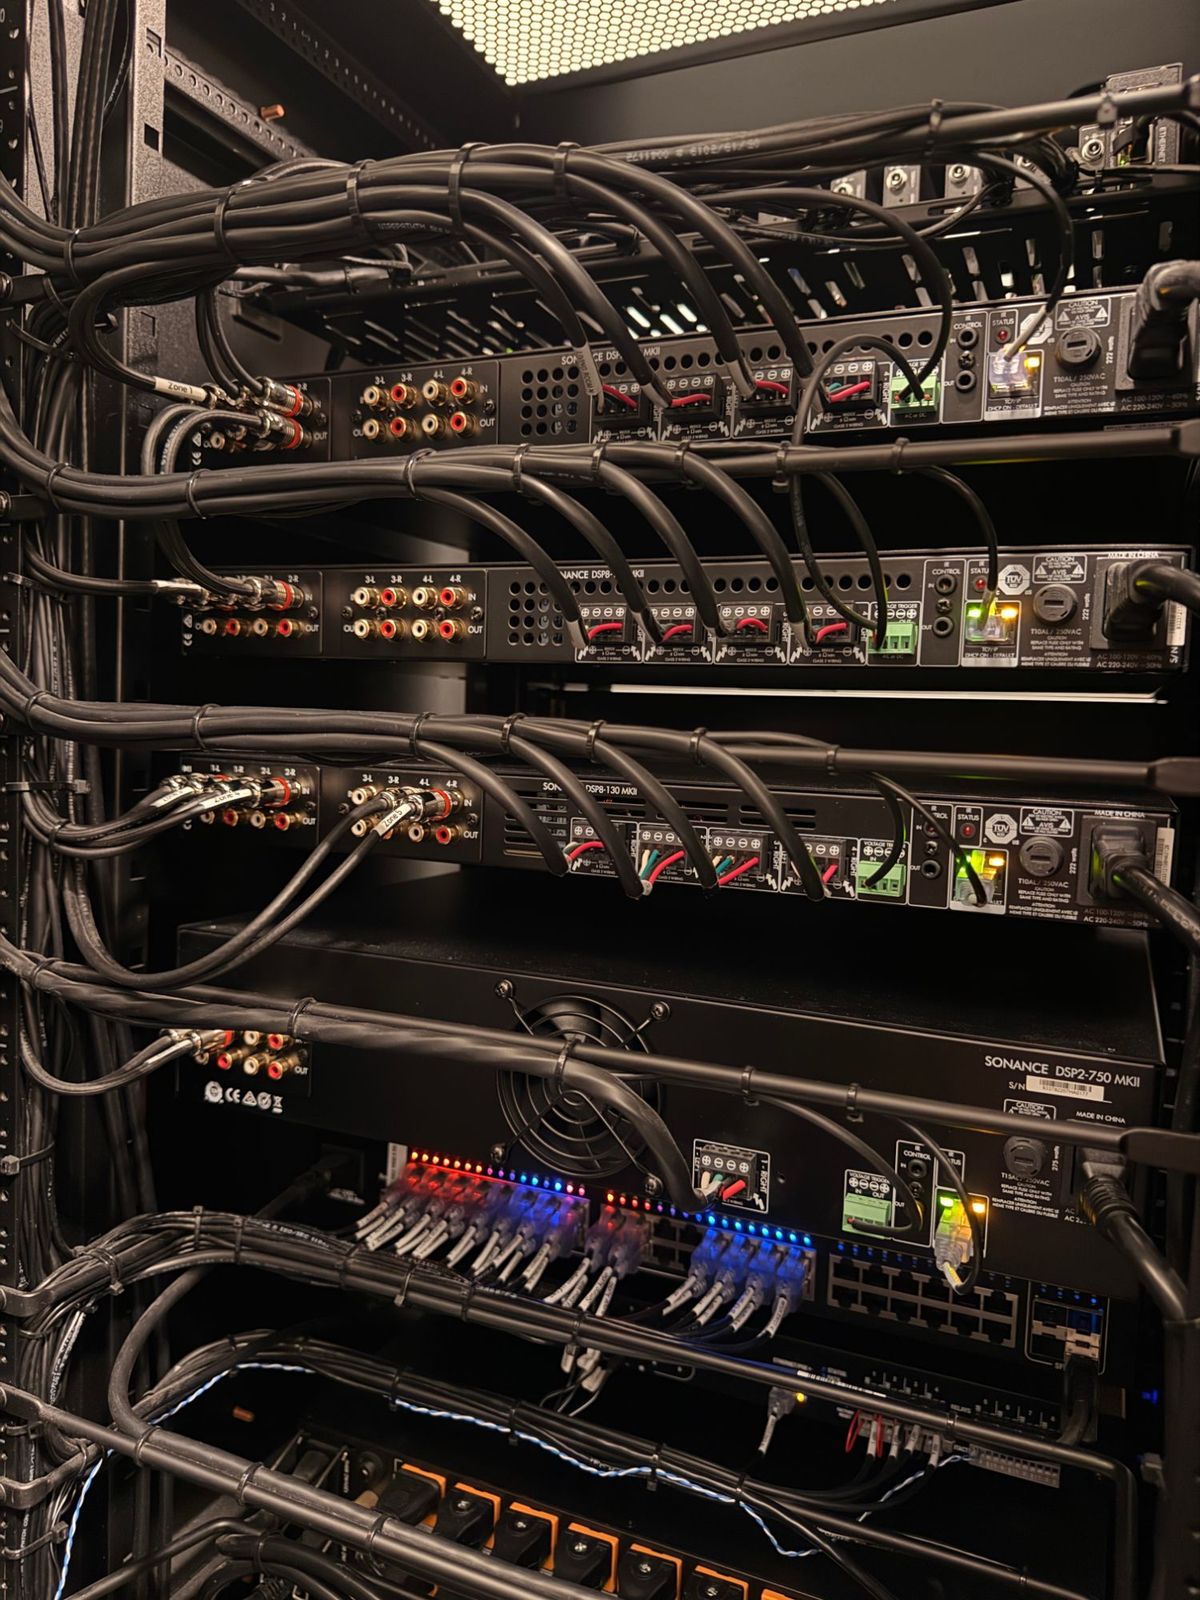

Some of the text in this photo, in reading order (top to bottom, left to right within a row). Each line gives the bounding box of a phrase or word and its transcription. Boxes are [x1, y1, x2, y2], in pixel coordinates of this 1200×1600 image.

[954, 321, 983, 331] CONTROL
[992, 319, 1014, 328] STATUS
[561, 351, 604, 366] SONCE
[433, 370, 444, 379] 4-L
[461, 367, 473, 376] 4-R
[374, 376, 385, 385] 3-L
[401, 373, 413, 383] 3-R
[168, 380, 188, 393] Zone
[479, 385, 489, 393] IN
[314, 401, 322, 409] IN
[479, 418, 496, 428] OUT
[313, 432, 327, 442] OUT
[932, 568, 961, 577] CONTROL
[971, 568, 989, 577] STATU
[288, 575, 299, 583] 2-R
[365, 575, 375, 583] 3-L
[391, 575, 402, 583] 3-R
[423, 575, 433, 583] 4-L
[450, 575, 461, 583] 4-R
[468, 593, 476, 601] IN
[305, 624, 319, 633] OUT
[467, 626, 483, 635] OUT
[285, 769, 296, 777] 2-R
[362, 775, 373, 783] 3-L
[388, 776, 399, 785] 3-R
[419, 779, 430, 788] 4-L
[446, 781, 458, 789] 4-R
[586, 785, 638, 796] DSP8-130 MKII
[464, 800, 473, 808] IN
[1033, 808, 1062, 817] CAUTION
[1095, 809, 1115, 817] MADE
[302, 818, 317, 827] OUT
[957, 814, 980, 822] STATUS
[463, 831, 479, 841] OUT
[863, 840, 886, 848] VOLTAGE
[850, 857, 858, 876] RIGHT
[295, 1066, 309, 1075] OUT
[985, 1056, 1141, 1088] SONANCE DSP2-750 MKII
[1008, 1081, 1026, 1091] S/N
[1016, 1102, 1044, 1111] CAUTION
[1076, 1111, 1096, 1120] MADE
[1105, 1115, 1126, 1125] CHINA
[904, 1150, 932, 1161] CONTROL
[760, 1171, 769, 1194] RIGHT
[872, 1191, 885, 1199] OUT
[894, 1200, 905, 1208] OUT
